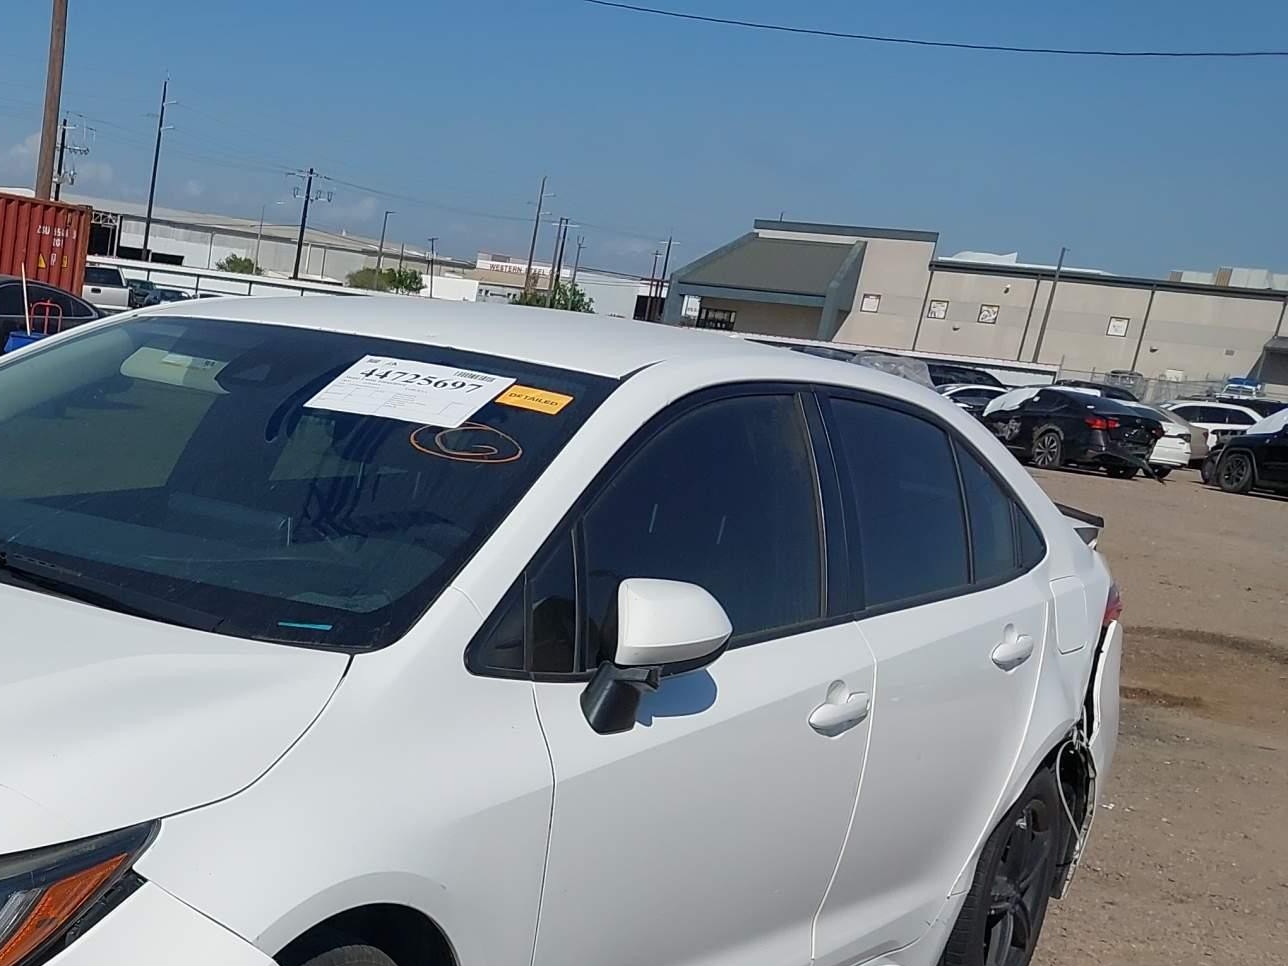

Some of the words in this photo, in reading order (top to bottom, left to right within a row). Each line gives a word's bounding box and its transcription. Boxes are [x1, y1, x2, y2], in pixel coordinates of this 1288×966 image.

[489, 263, 523, 273] WESTERN
[359, 367, 484, 394] 44725697
[508, 392, 559, 406] DETAILED
